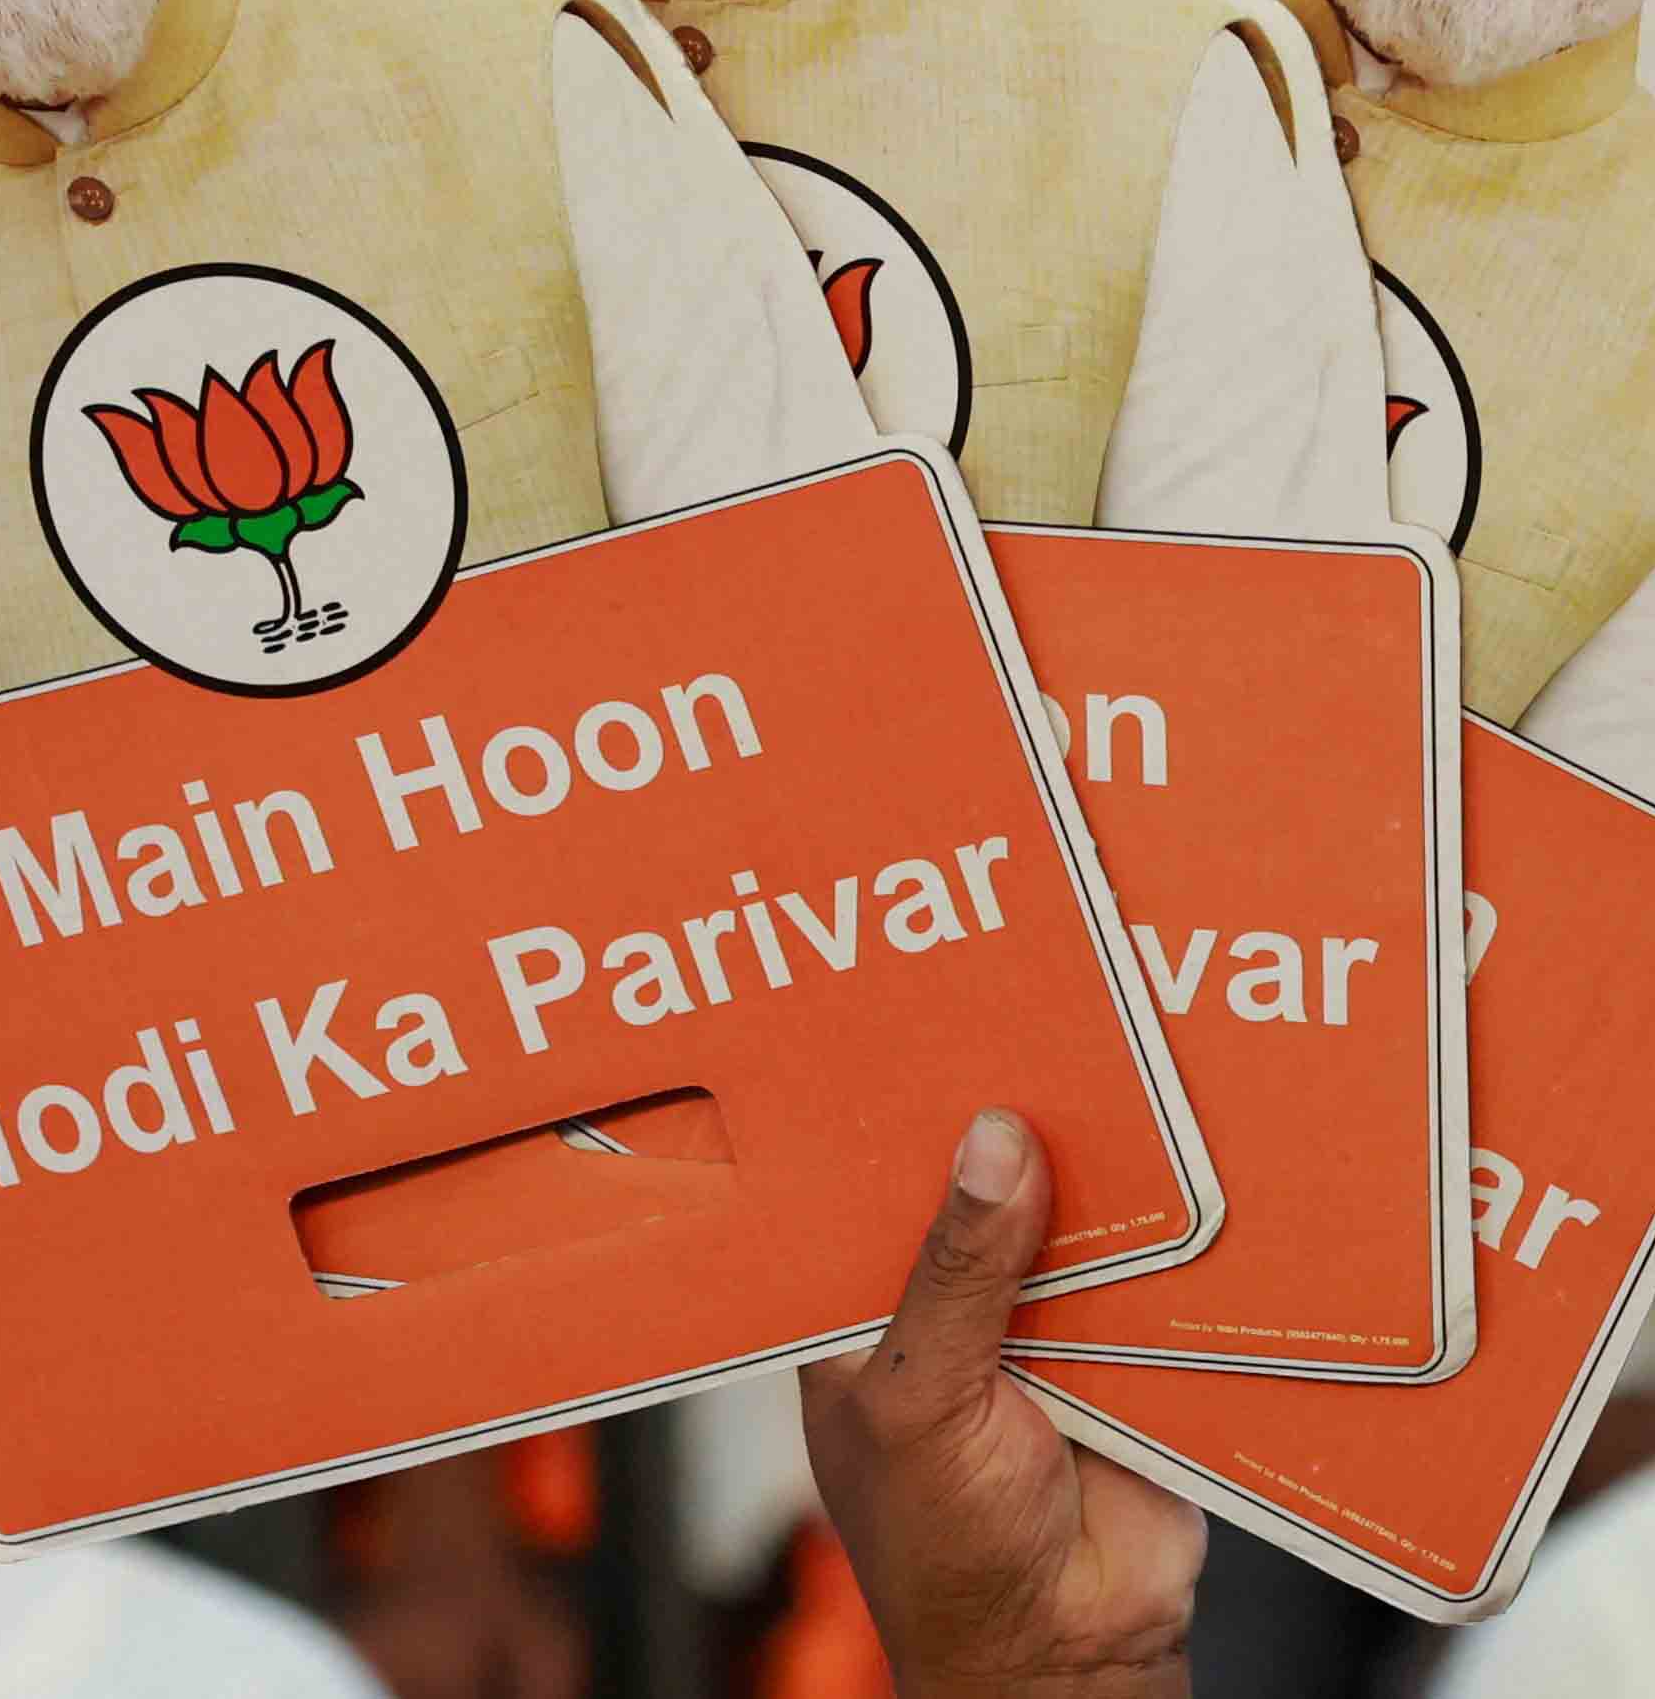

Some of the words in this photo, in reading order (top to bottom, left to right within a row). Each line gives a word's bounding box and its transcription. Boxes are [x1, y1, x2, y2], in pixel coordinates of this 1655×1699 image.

[355, 673, 763, 852] Hoon
[253, 978, 470, 1117] Ka
[486, 836, 1009, 1055] Parivar
